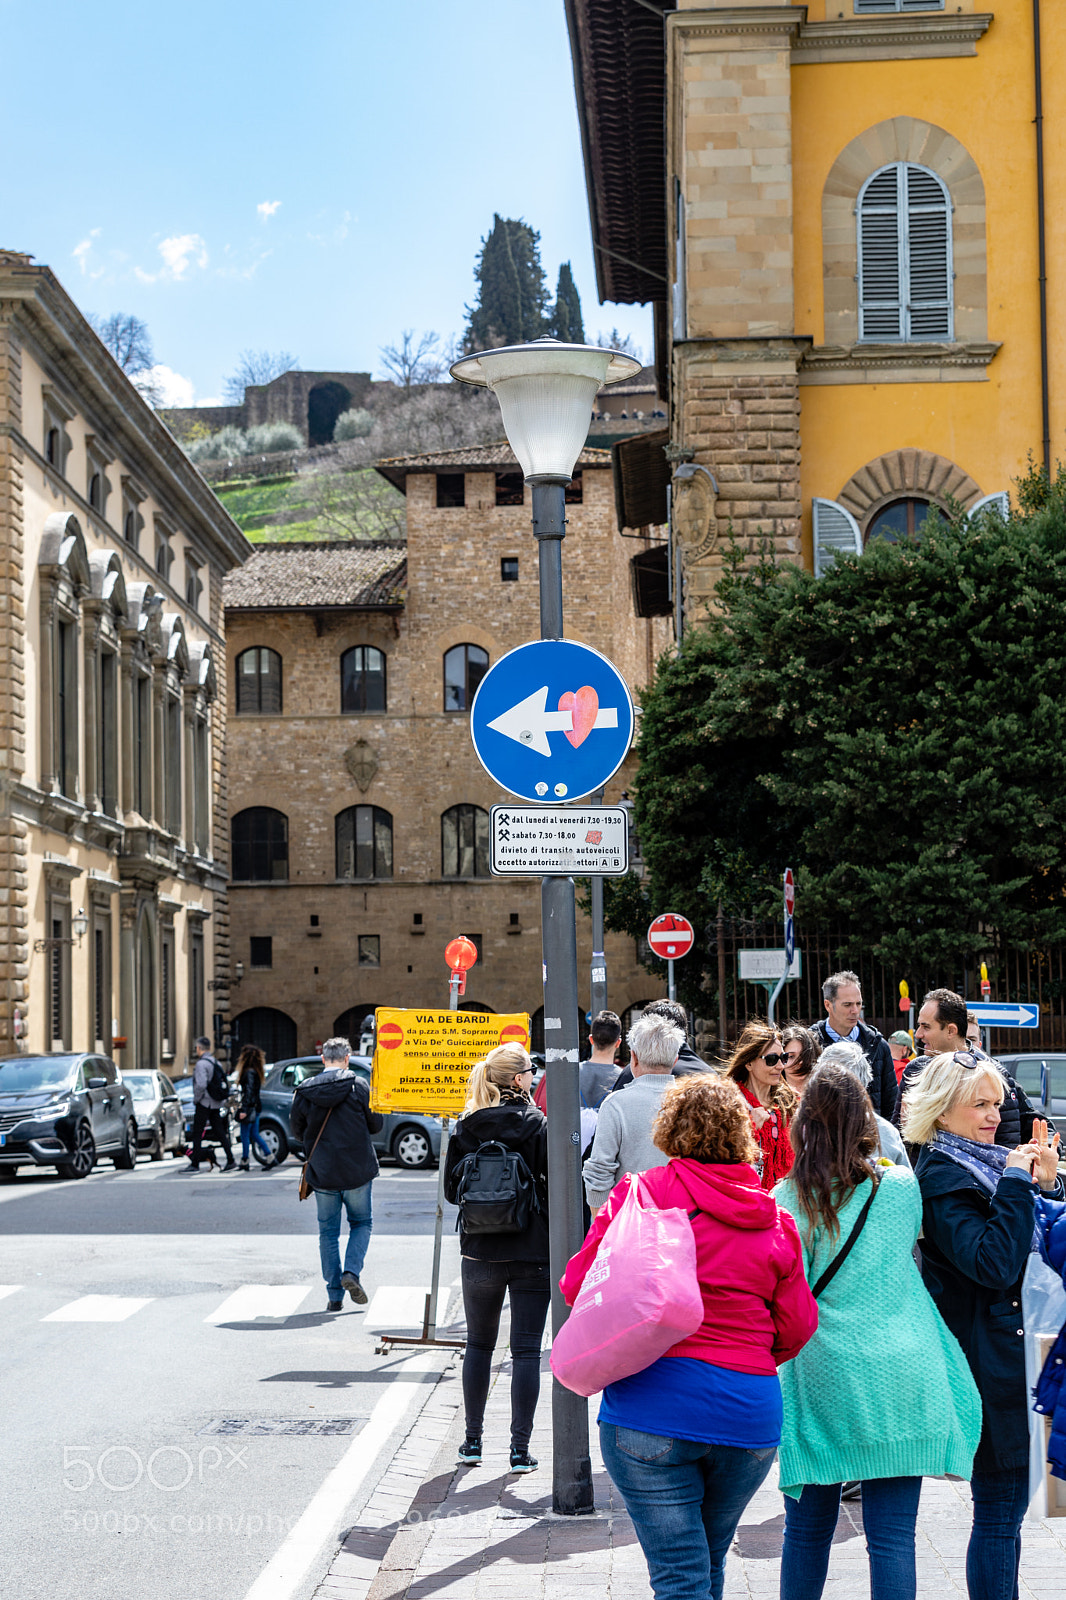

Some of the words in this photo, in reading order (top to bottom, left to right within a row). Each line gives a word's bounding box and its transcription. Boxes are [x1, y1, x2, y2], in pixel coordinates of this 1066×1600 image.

[511, 816, 524, 824] dal
[525, 816, 549, 824] lunedi
[549, 816, 558, 824] al
[559, 816, 586, 824] venerdi
[511, 831, 537, 839] sabato
[500, 846, 528, 854] divieto
[530, 846, 538, 854] di
[541, 846, 573, 854] transito
[576, 846, 620, 854] autoveicoli
[415, 1015, 436, 1023] VIA
[438, 1015, 453, 1024] DE
[456, 1015, 490, 1024] BARDI
[462, 1028, 499, 1036] Soprarno
[446, 1039, 501, 1047] Guicciardini
[421, 1062, 431, 1070] in
[399, 1075, 431, 1085] piazza
[434, 1076, 456, 1084] S.M.
